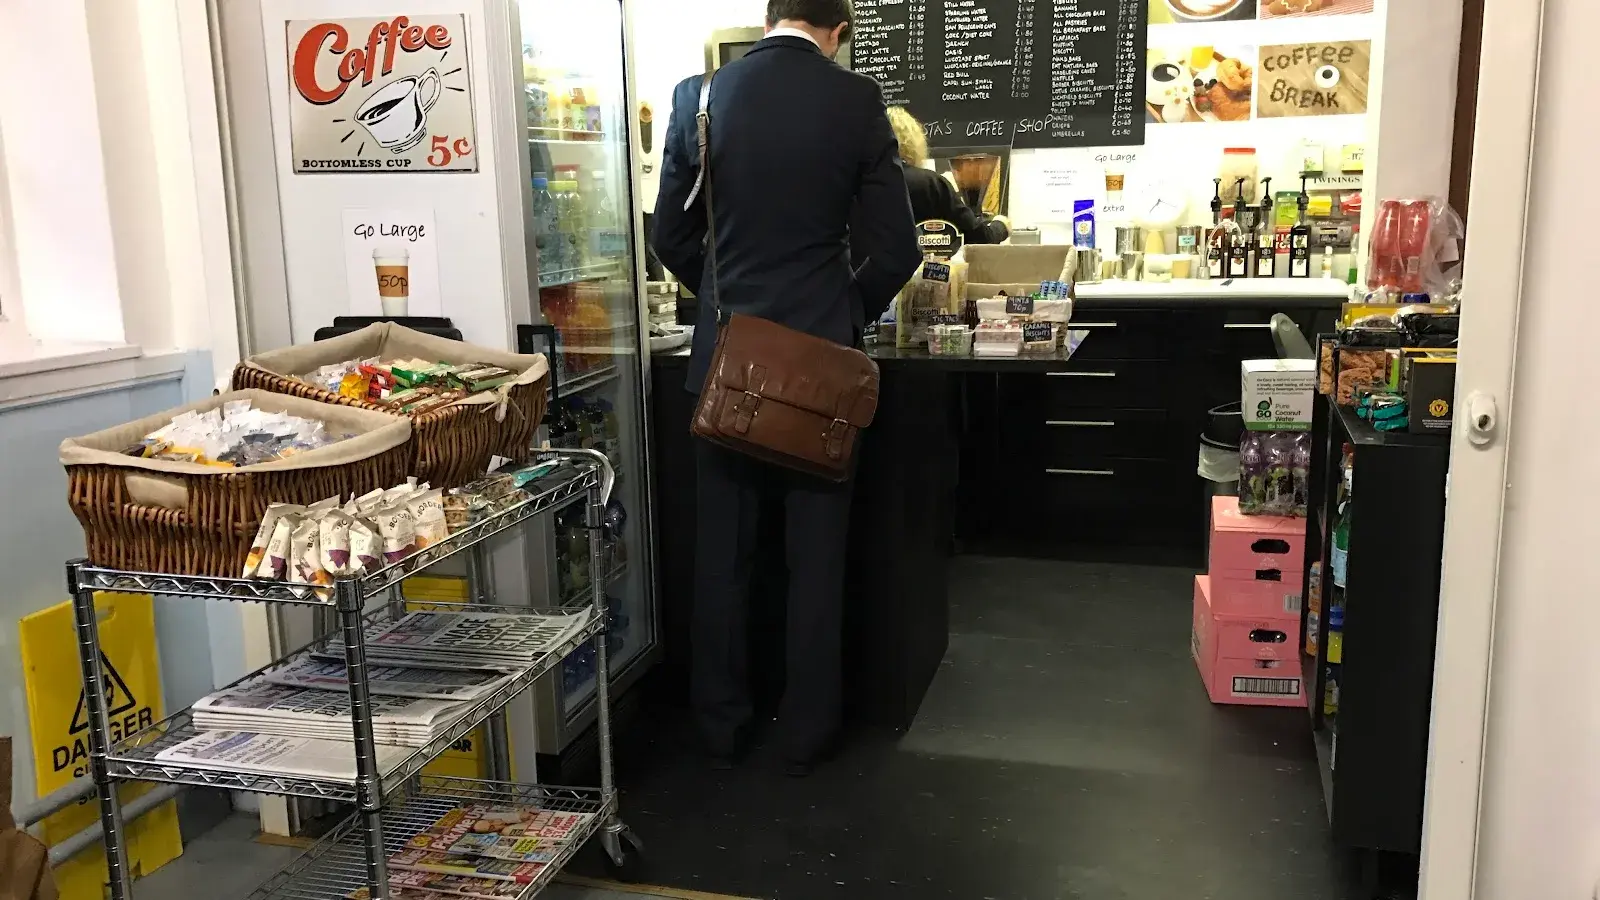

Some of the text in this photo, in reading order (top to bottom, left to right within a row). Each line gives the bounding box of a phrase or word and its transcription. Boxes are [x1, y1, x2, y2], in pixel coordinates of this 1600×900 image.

[294, 15, 452, 105] Coffee
[1270, 79, 1339, 108] BREAK
[966, 120, 1004, 136] COFFEE
[1017, 114, 1053, 132] SHOP
[427, 135, 472, 167] 5¢
[1110, 154, 1136, 163] Large
[302, 159, 411, 168] BOTTOMLESS CUP
[1103, 204, 1125, 212] extra
[354, 224, 426, 242] Go Large
[920, 236, 950, 244] Biscotti
[380, 275, 408, 294] 50p
[1013, 304, 1026, 312] 70p
[52, 706, 152, 772] DAGER
